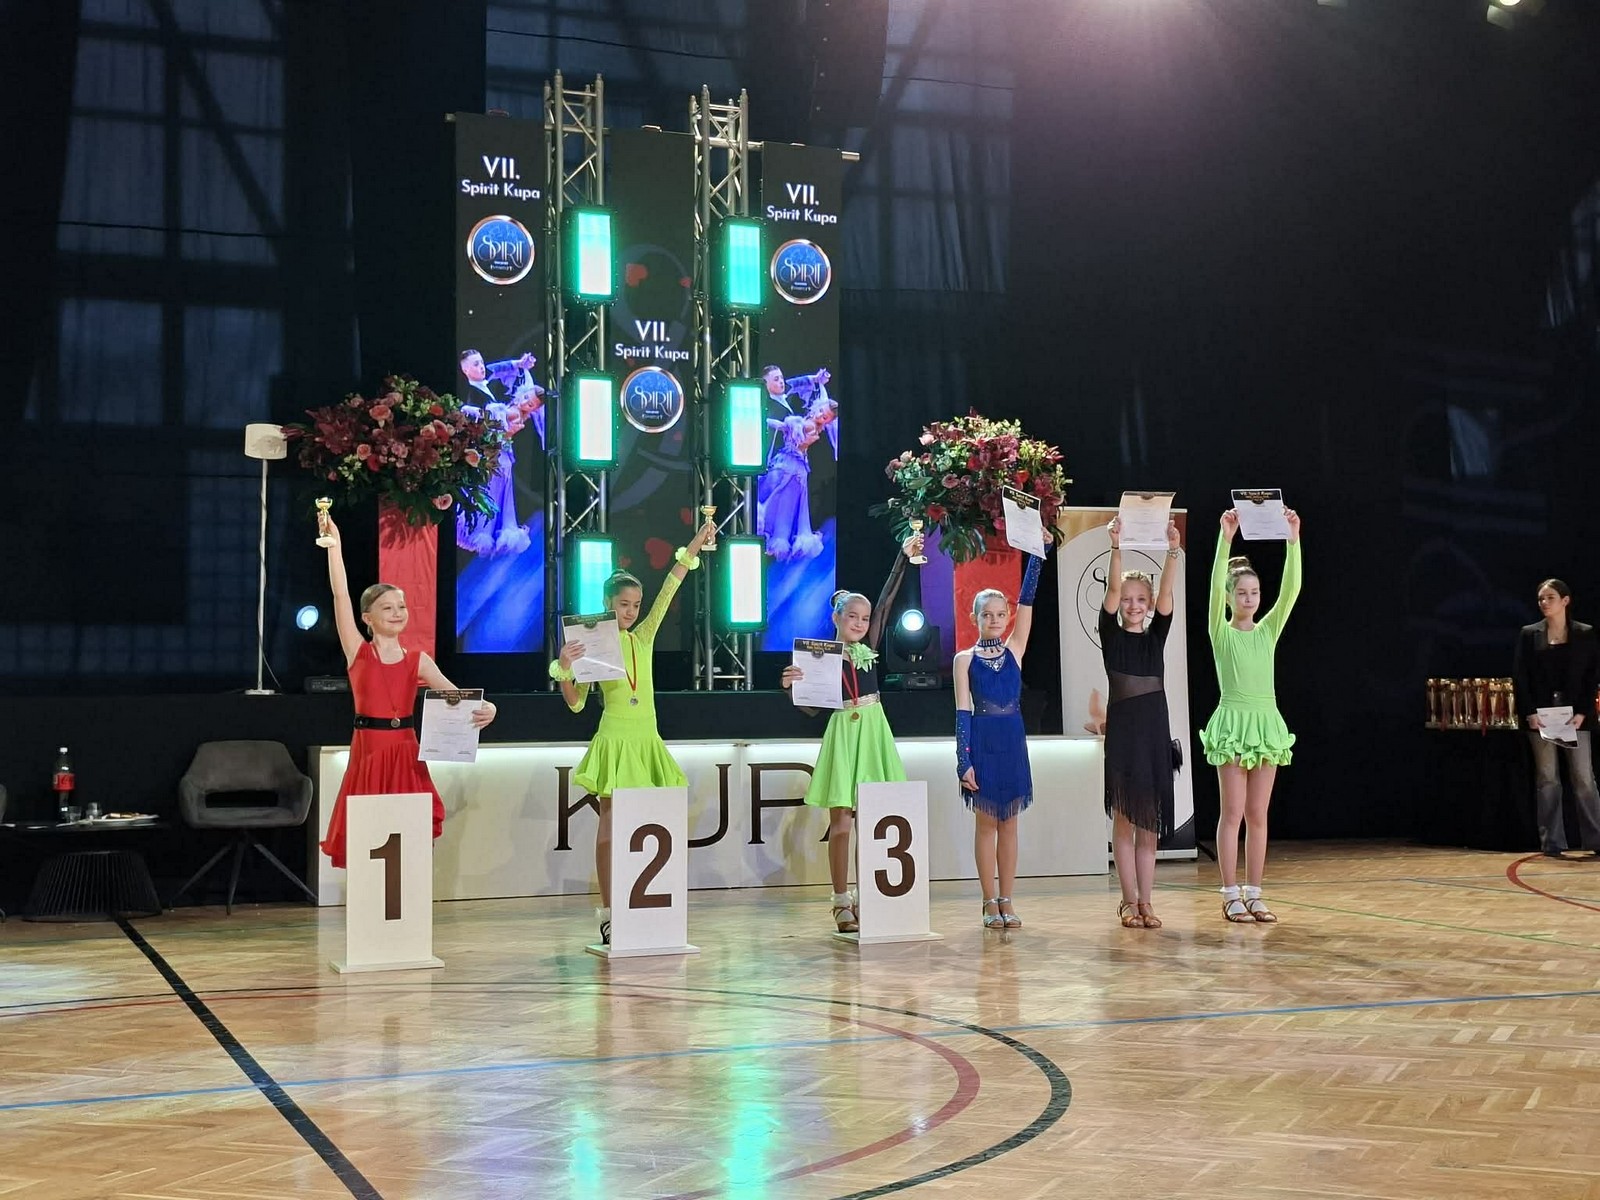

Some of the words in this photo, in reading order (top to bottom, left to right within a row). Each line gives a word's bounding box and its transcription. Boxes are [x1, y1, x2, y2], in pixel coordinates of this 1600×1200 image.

[482, 155, 521, 180] VII.
[461, 179, 499, 197] Spirit
[504, 182, 540, 201] Kupa
[785, 182, 820, 206] VII.
[766, 205, 800, 222] Spirit
[804, 208, 838, 226] Kupa
[634, 319, 671, 342] VII.
[615, 343, 650, 360] Spirit
[655, 345, 689, 361] Kupa
[628, 822, 673, 910] 2
[873, 814, 916, 898] 3
[369, 832, 402, 921] 1
